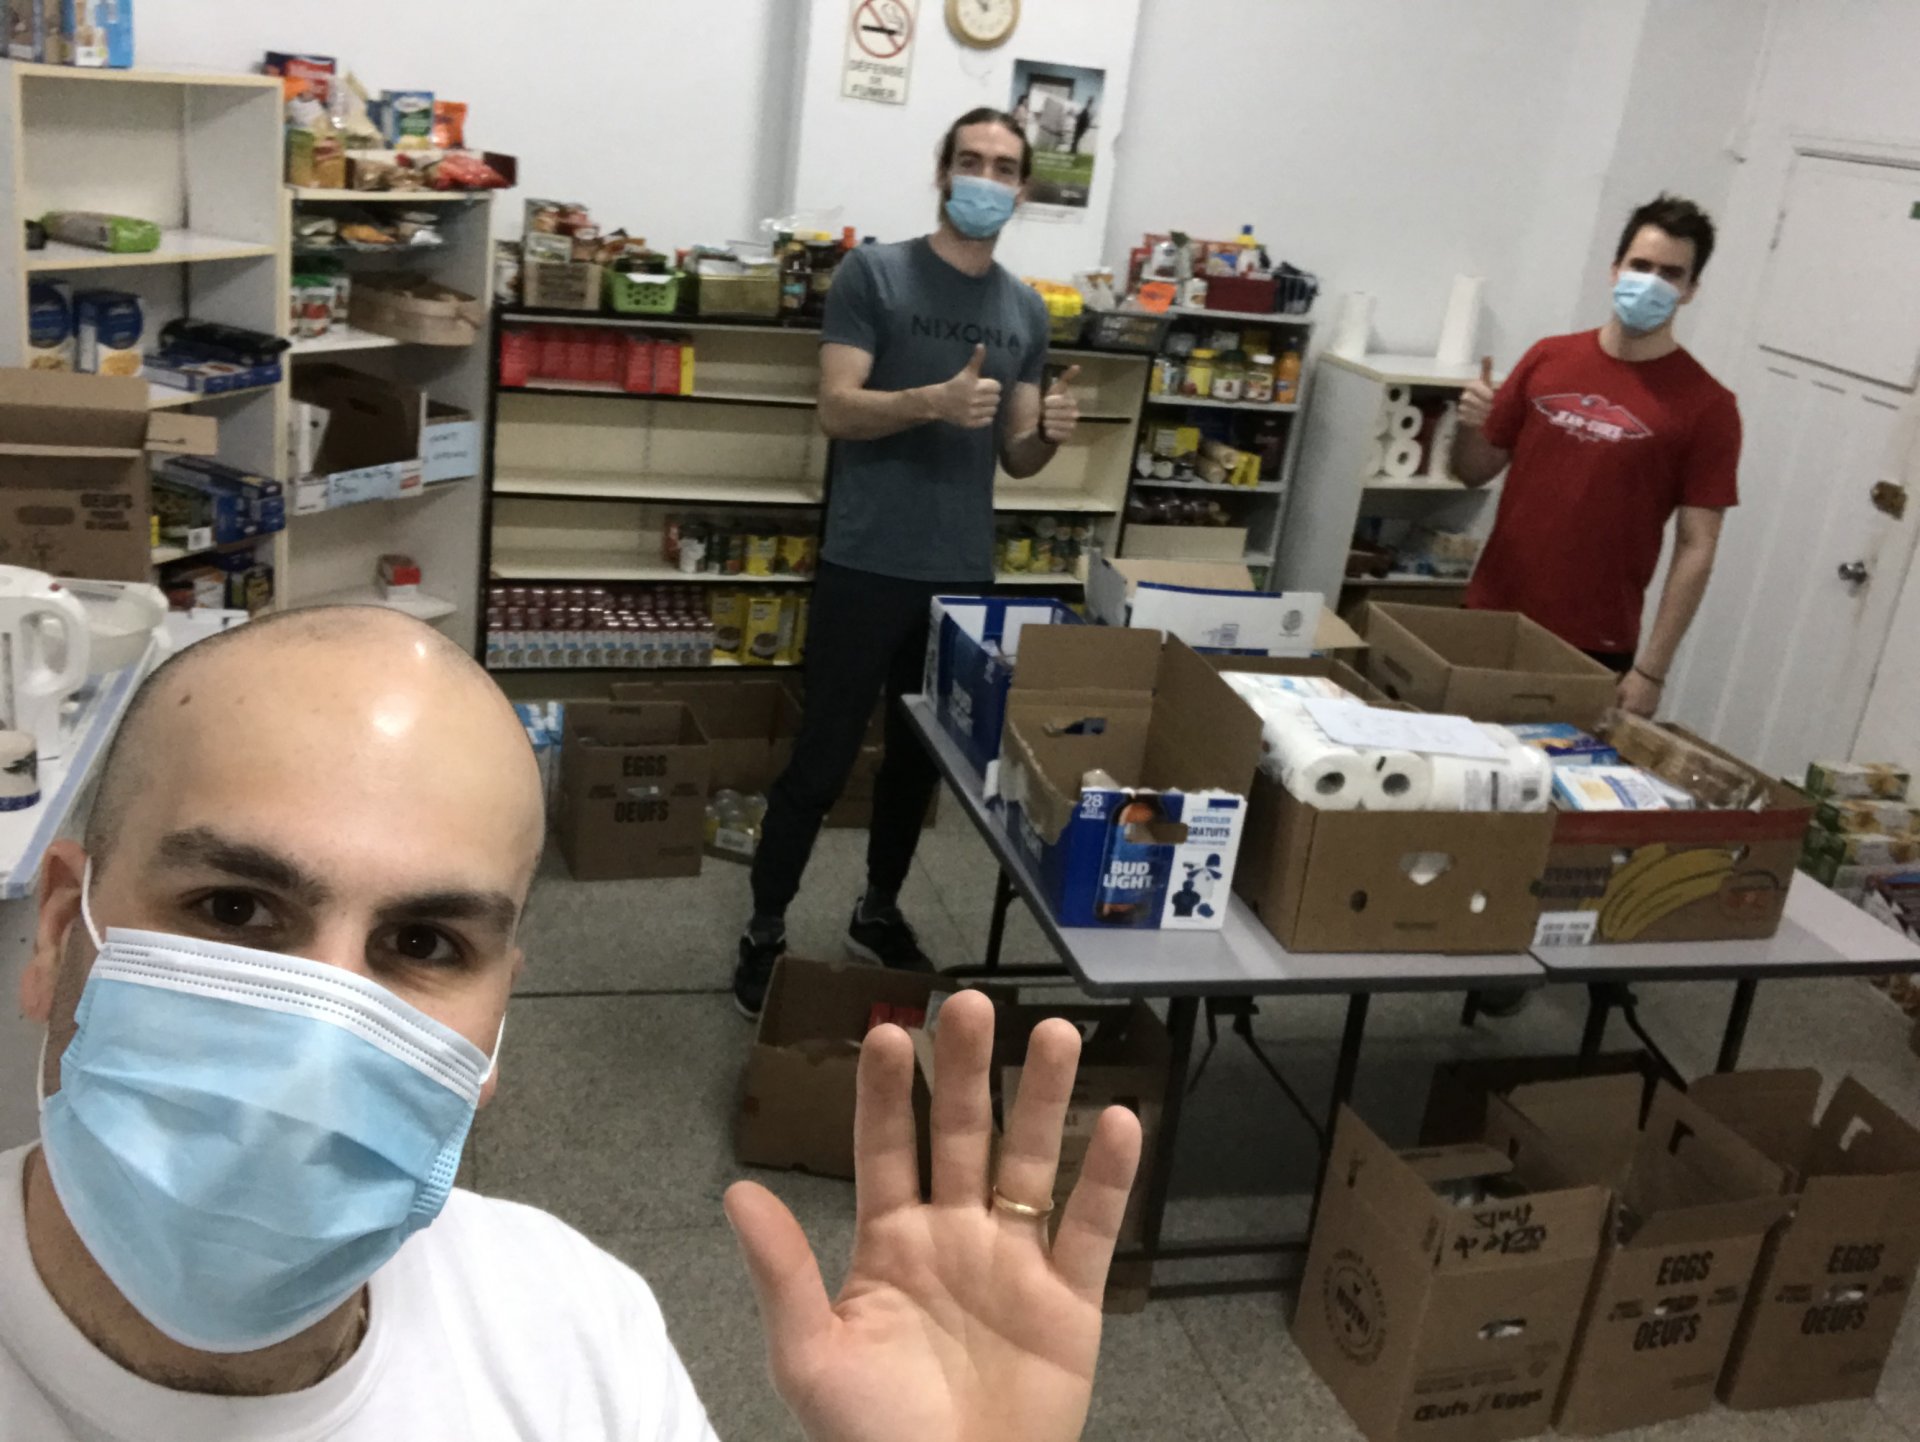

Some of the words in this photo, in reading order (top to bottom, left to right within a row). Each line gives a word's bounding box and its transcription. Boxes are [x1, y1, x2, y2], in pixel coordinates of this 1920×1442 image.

[852, 84, 897, 98] FUMER
[911, 314, 1002, 349] NIXON
[621, 755, 668, 777] EGGS
[614, 800, 670, 823] OEUFS
[1082, 793, 1103, 808] 28
[1110, 861, 1150, 876] BUD
[1103, 874, 1153, 889] LIGHT
[1656, 1250, 1715, 1286] EGGS
[1826, 1242, 1885, 1275] EGGS
[1801, 1301, 1870, 1335] OEUFS
[1633, 1312, 1702, 1352] OEUFS
